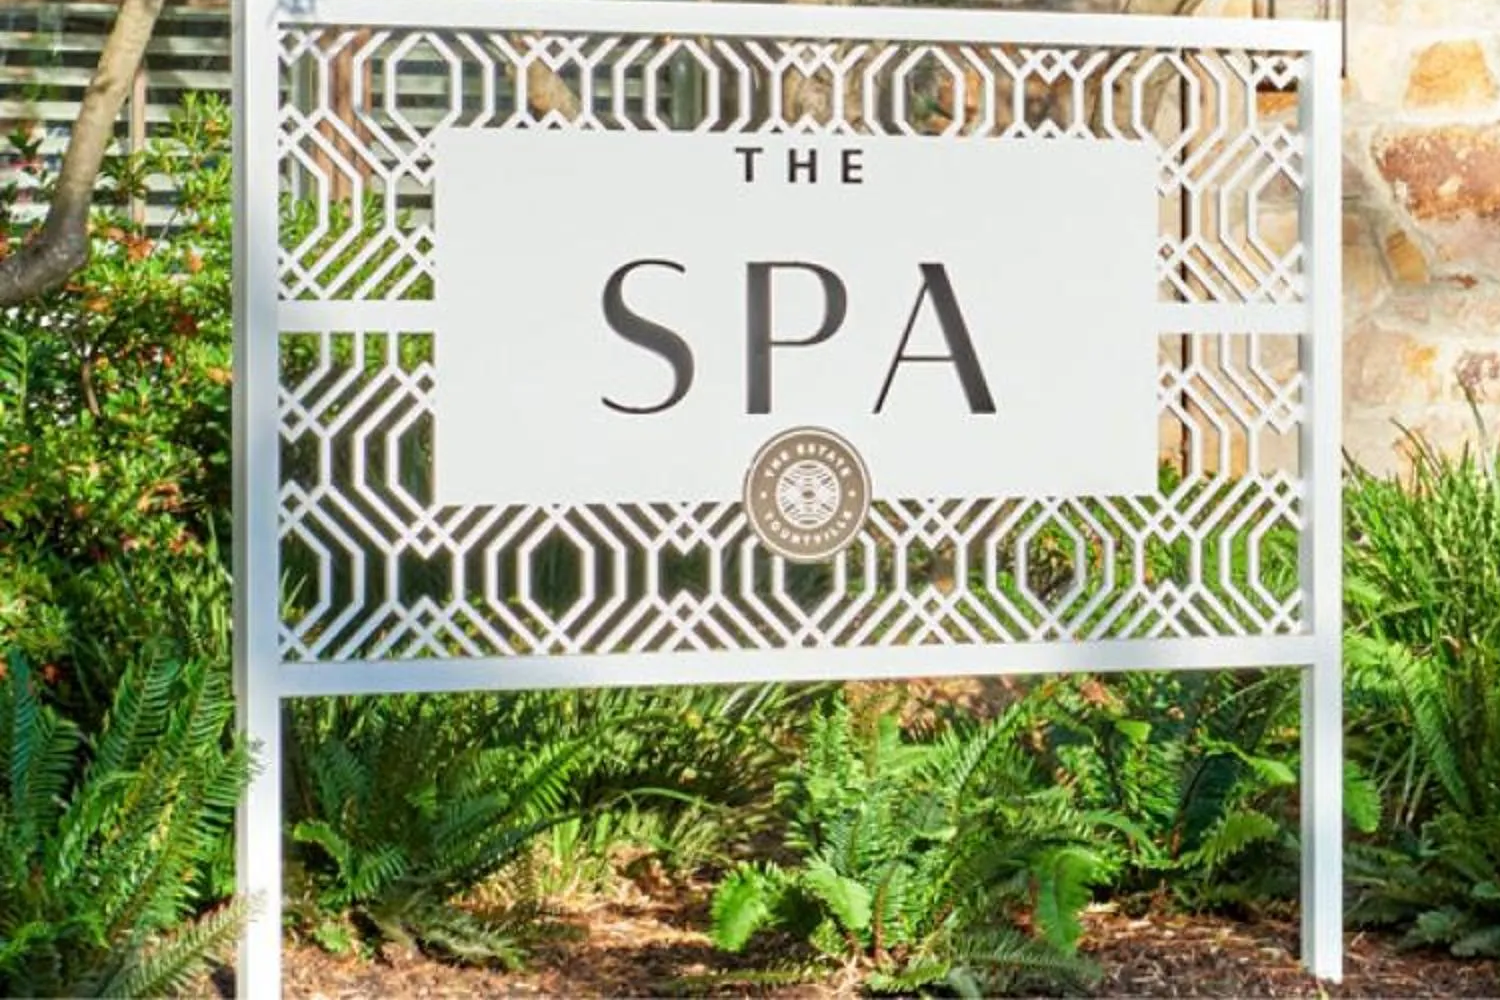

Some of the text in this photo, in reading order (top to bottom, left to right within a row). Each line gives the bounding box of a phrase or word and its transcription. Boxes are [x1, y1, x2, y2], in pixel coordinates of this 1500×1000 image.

[735, 146, 864, 184] THE
[601, 258, 997, 415] SPA
[764, 443, 852, 478] THE ESTATE
